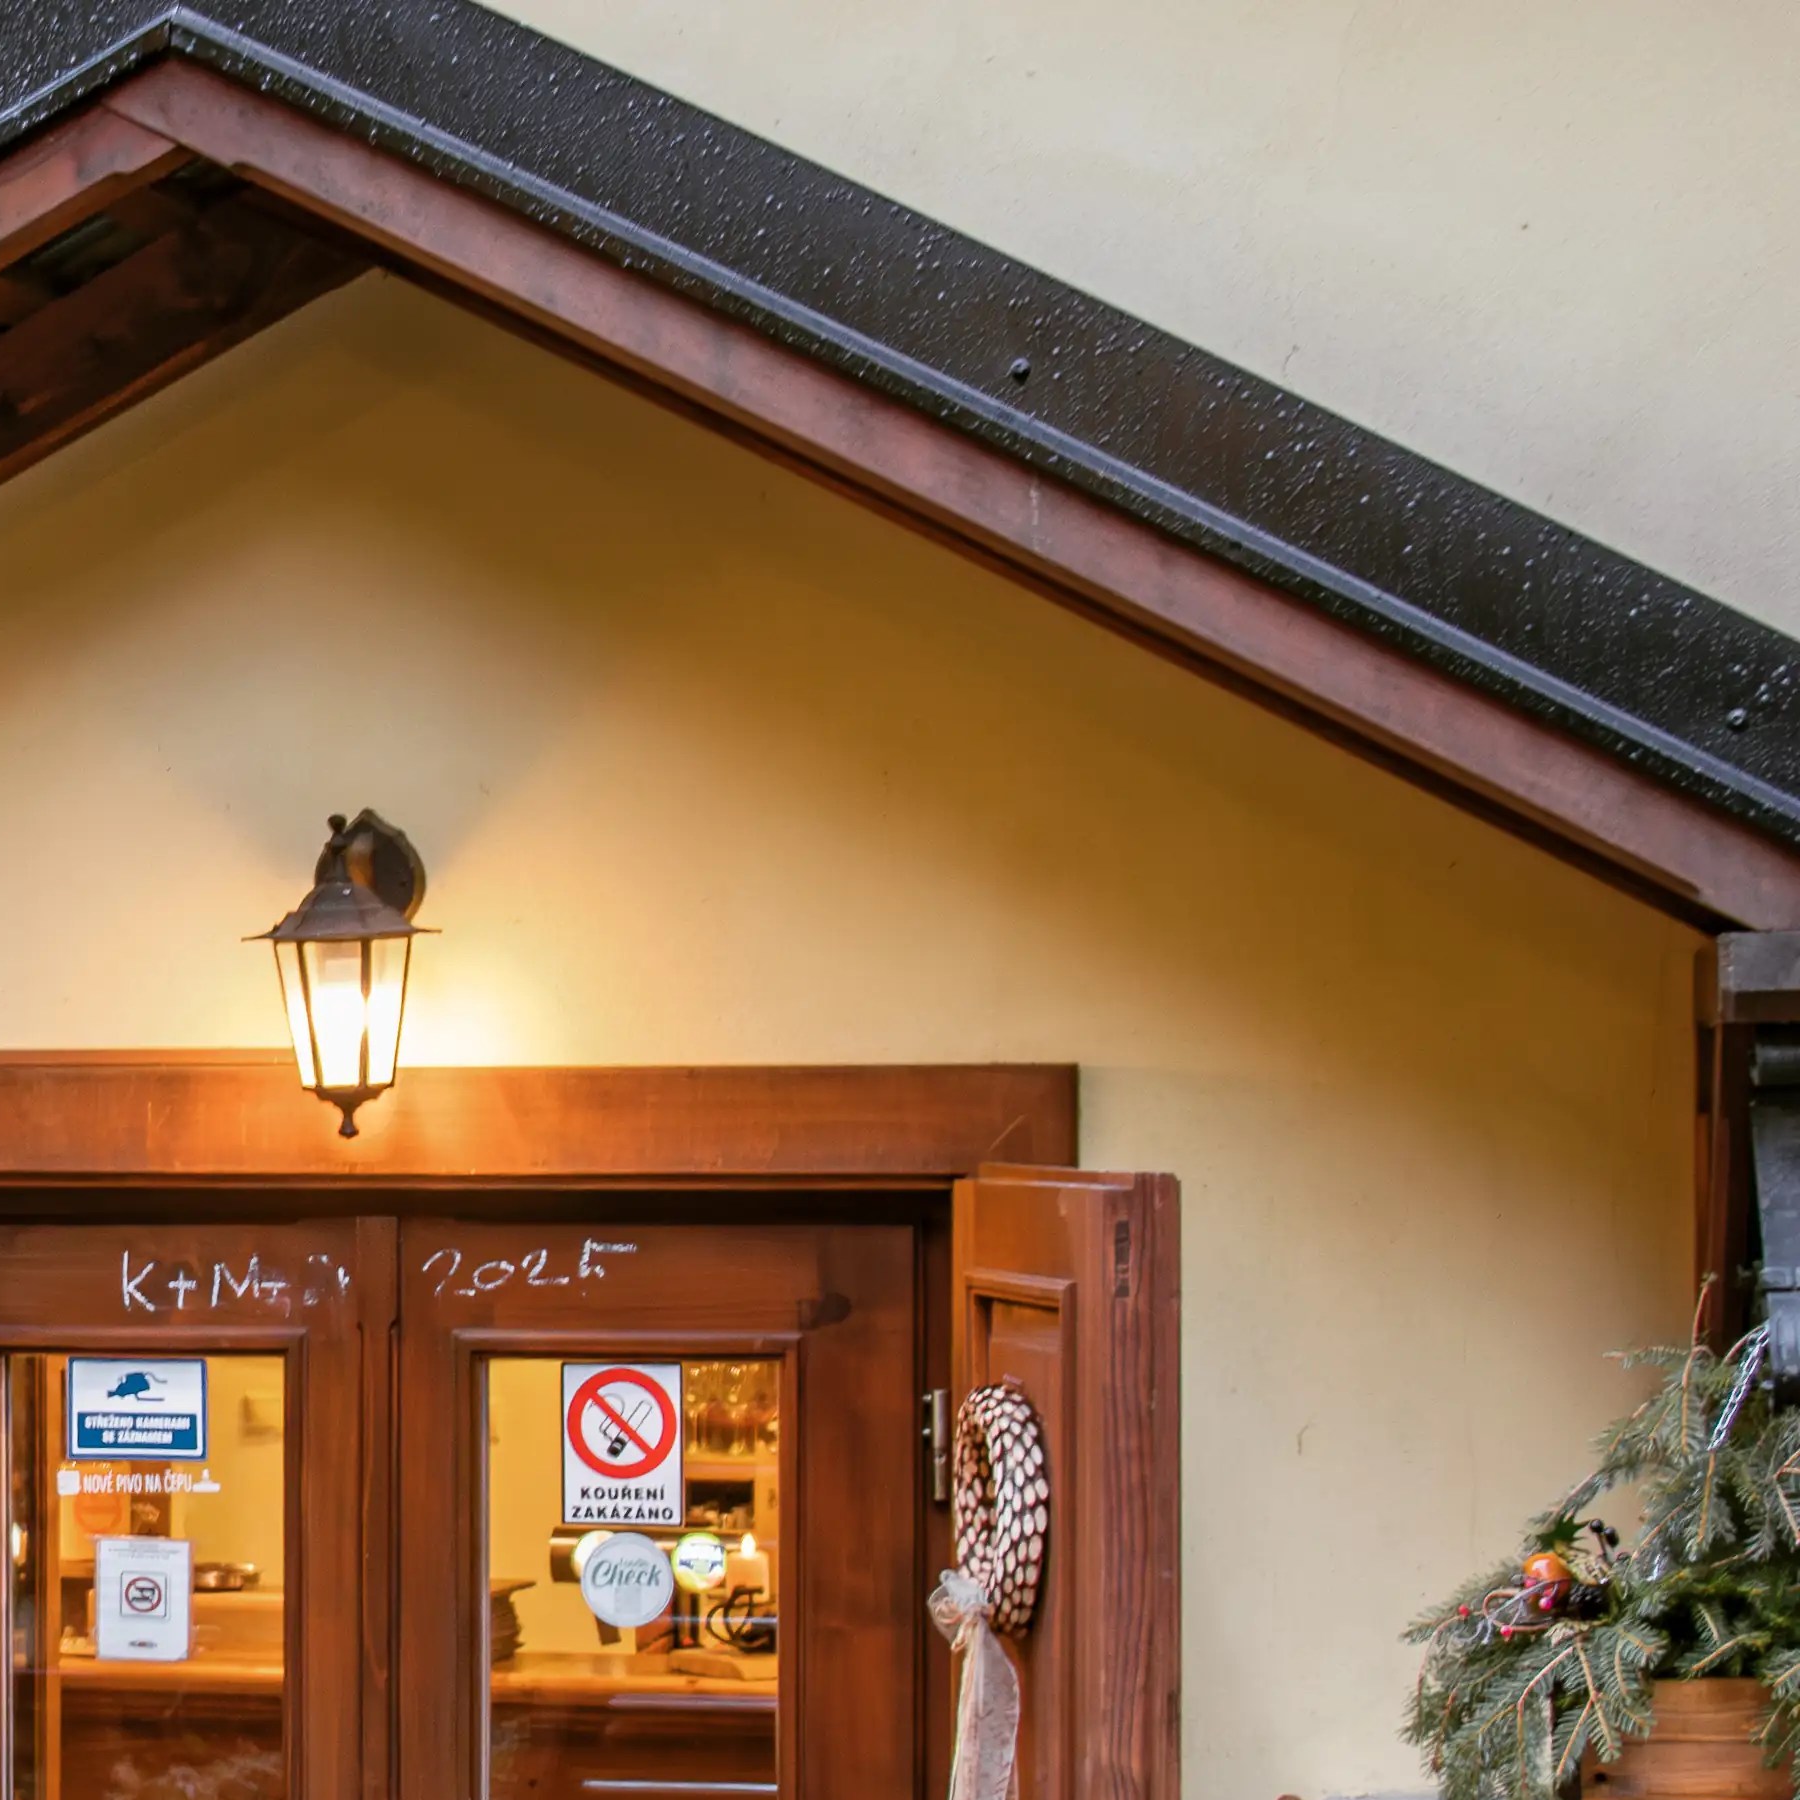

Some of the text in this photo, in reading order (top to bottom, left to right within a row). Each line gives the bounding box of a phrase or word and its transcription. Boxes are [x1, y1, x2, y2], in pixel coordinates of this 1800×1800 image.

[83, 1469, 193, 1494] NOVÉ PIVO NA ČEPU
[580, 1483, 666, 1501] KOUŘENÍ
[571, 1503, 674, 1521] ZAKÁZÁNO
[591, 1558, 663, 1588] Check
